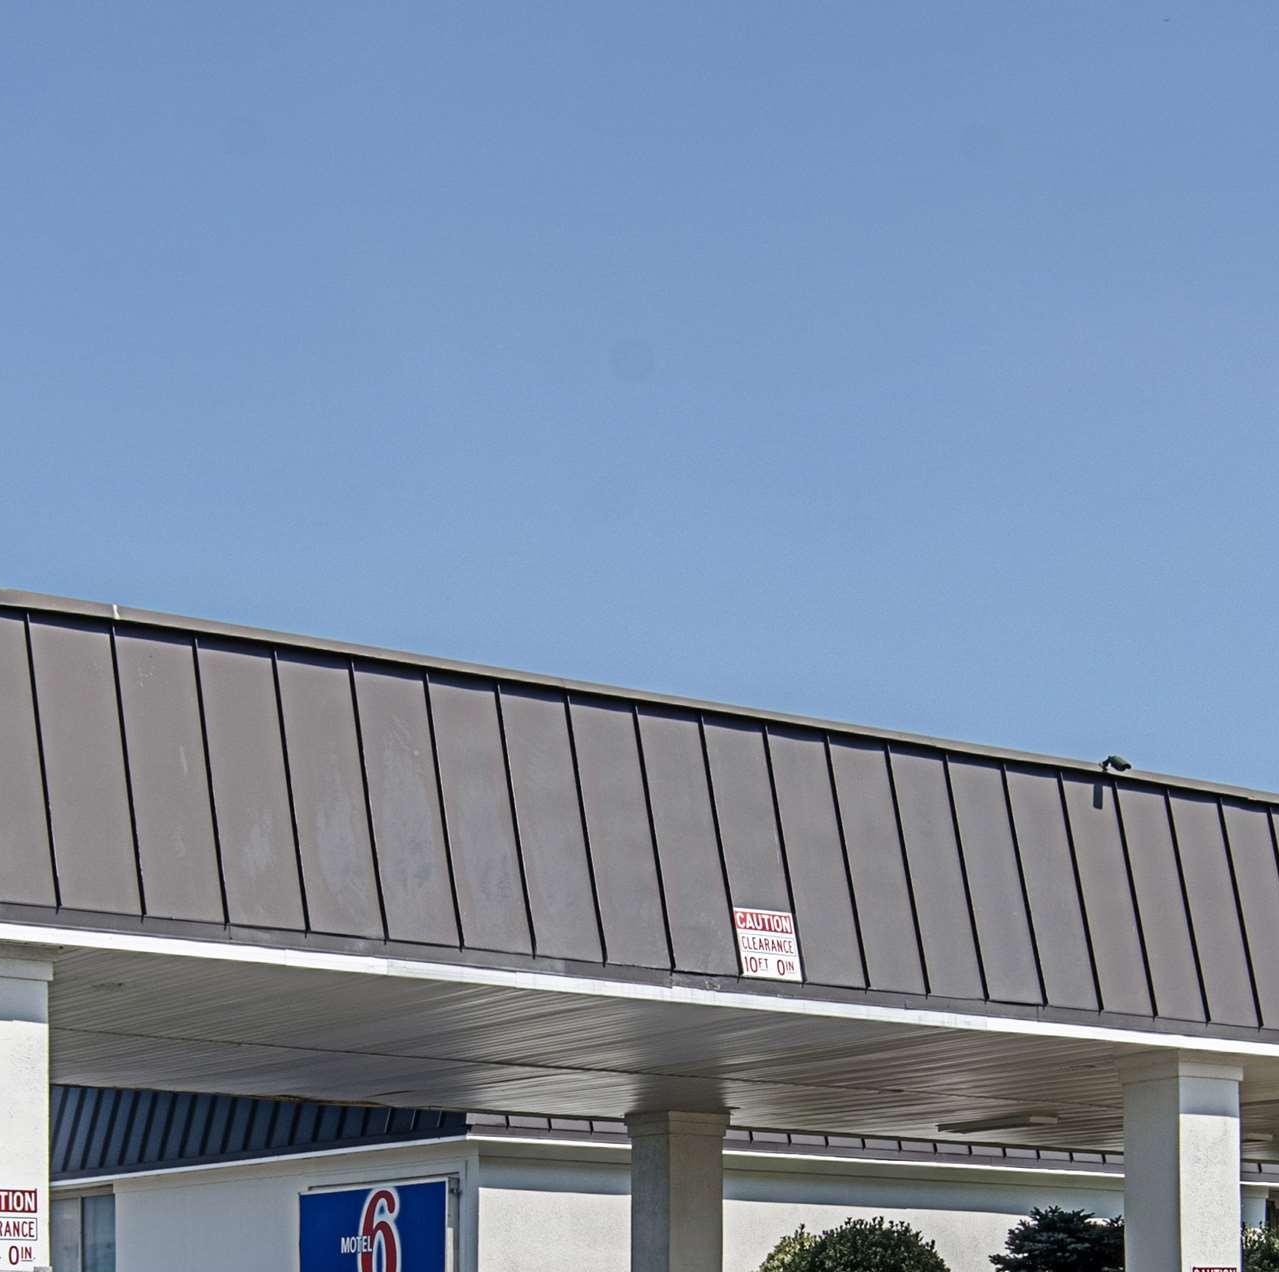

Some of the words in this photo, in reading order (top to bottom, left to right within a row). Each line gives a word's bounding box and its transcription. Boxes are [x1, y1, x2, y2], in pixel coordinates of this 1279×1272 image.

[736, 912, 791, 933] CAUTION
[741, 935, 794, 954] CLEARANCE
[340, 1235, 373, 1254] MOTEL
